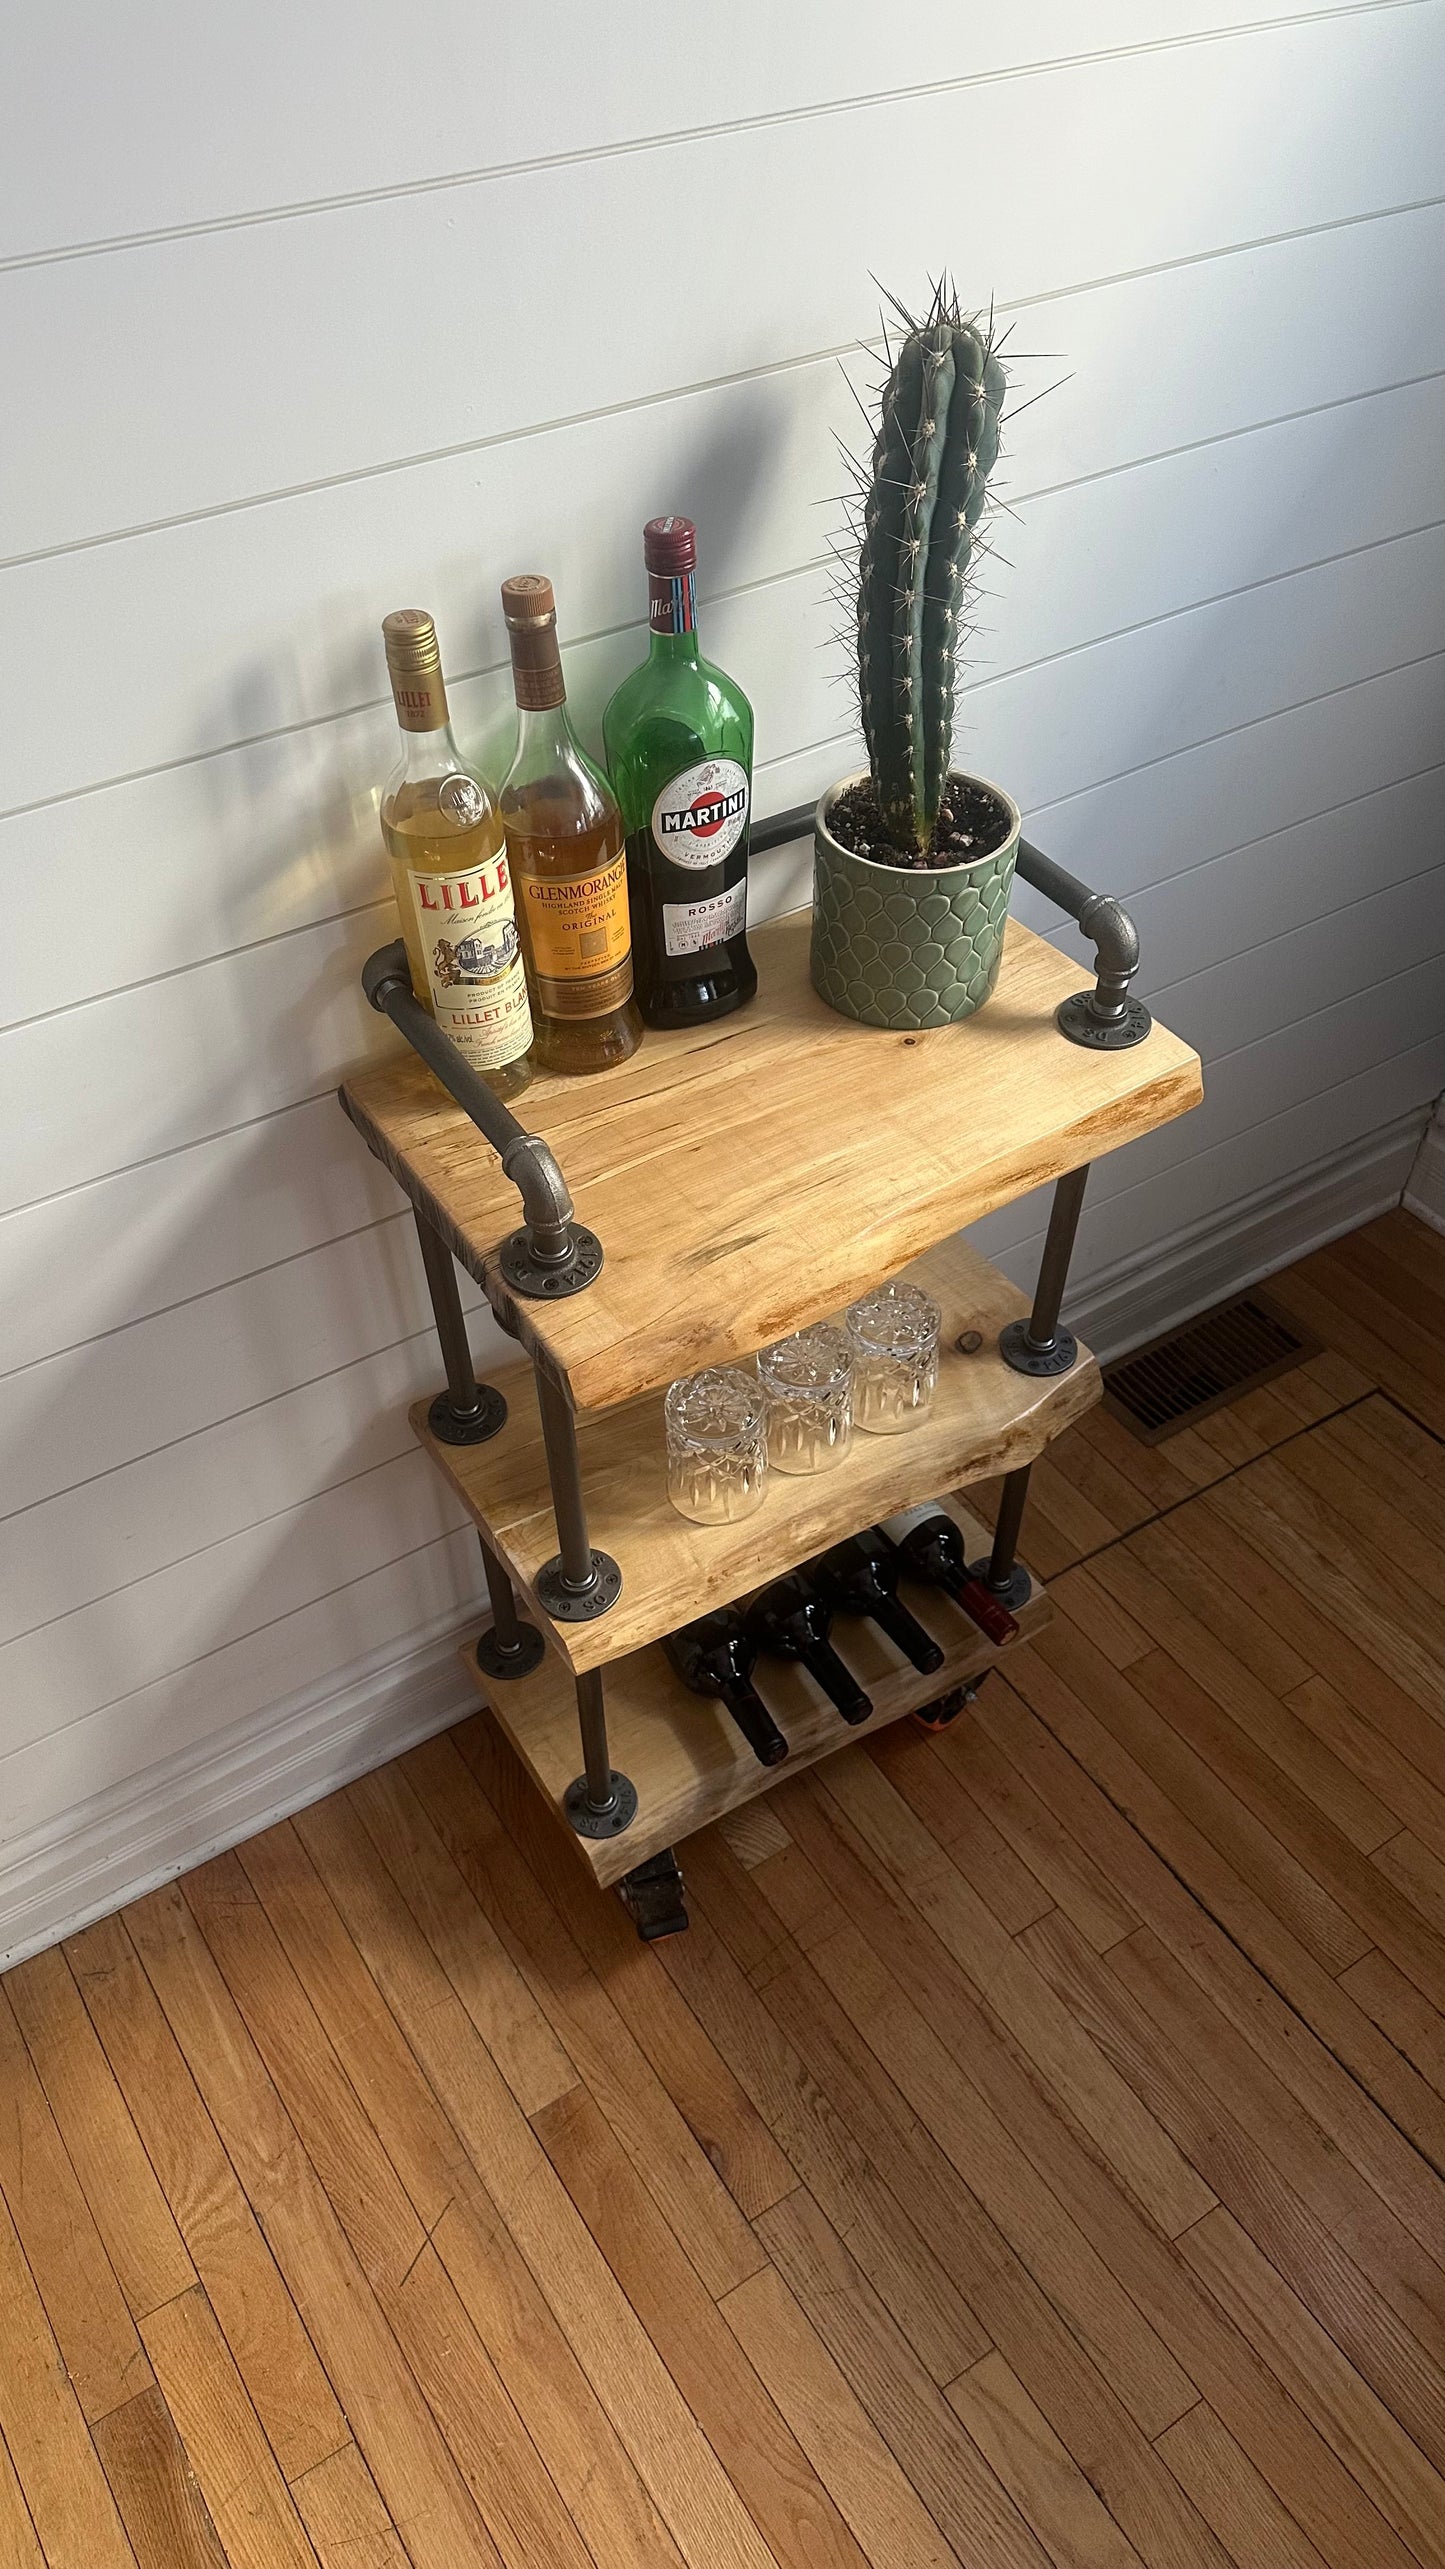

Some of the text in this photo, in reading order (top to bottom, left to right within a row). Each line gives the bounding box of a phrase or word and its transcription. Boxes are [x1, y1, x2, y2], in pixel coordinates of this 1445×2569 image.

[396, 689, 432, 708] LILLET
[664, 789, 744, 832] MARTINI
[417, 859, 509, 911] LILLE
[542, 900, 585, 909] HIGHLAND
[586, 890, 611, 904] SINGLE
[558, 893, 617, 916] SCOTCH WHISKY
[688, 895, 733, 917] ROSSO
[562, 908, 617, 931] ORIGINAL
[467, 987, 497, 998] PRODUCT
[452, 1006, 501, 1026] LILLET
